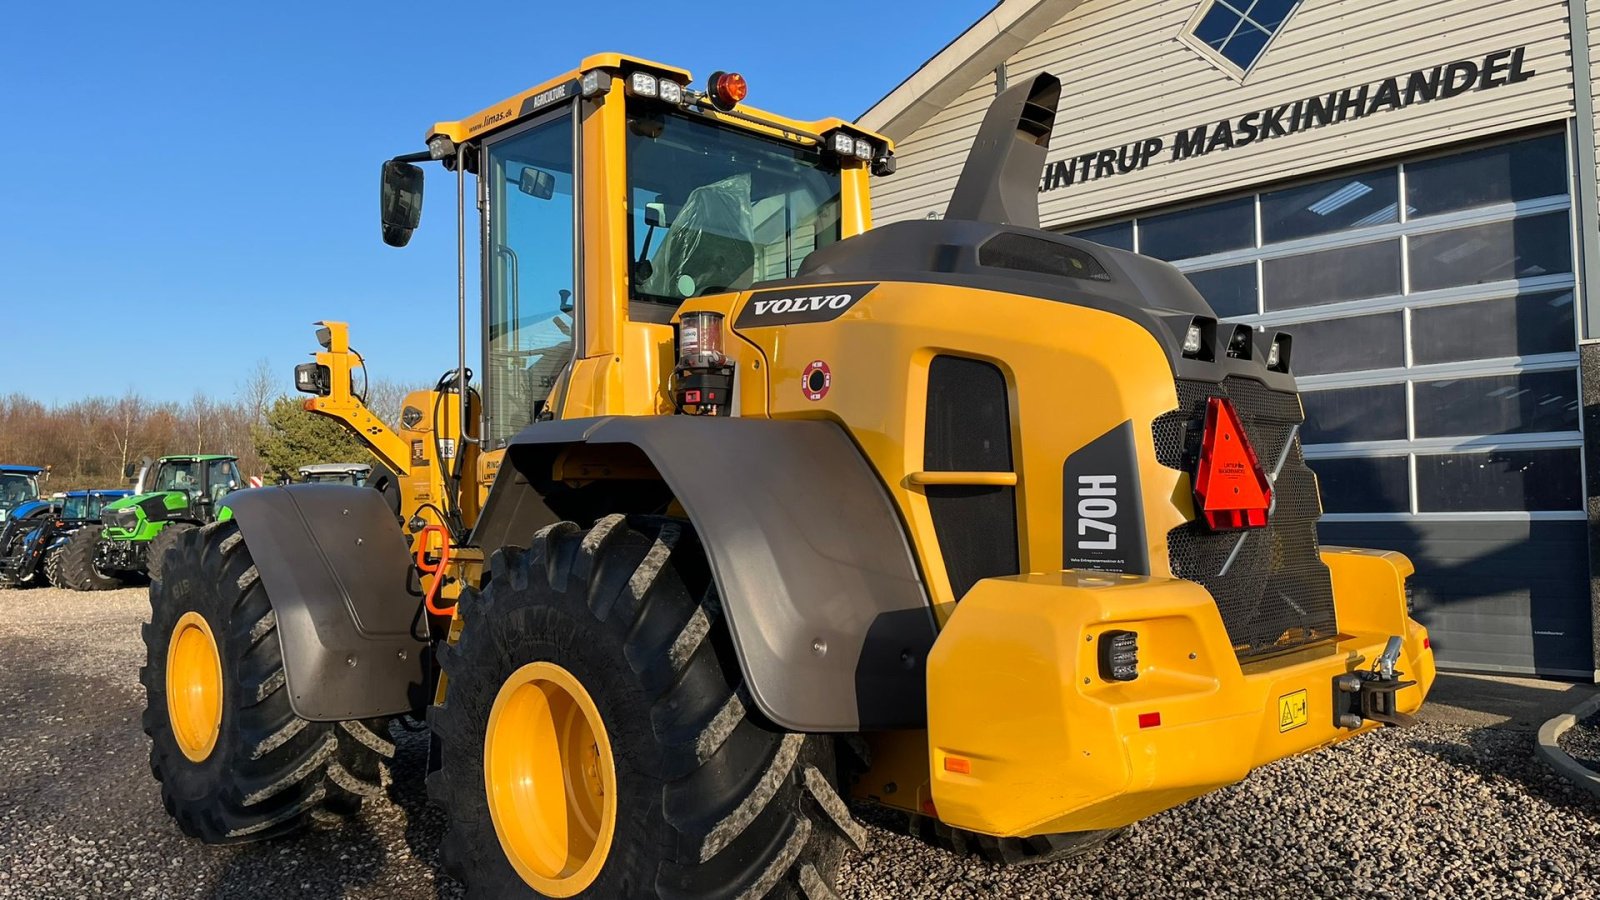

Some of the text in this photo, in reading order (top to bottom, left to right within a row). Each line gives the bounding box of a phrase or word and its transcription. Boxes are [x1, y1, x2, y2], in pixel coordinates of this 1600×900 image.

[533, 84, 566, 109] AGRICULTURE
[468, 108, 513, 133] www.limas.dk
[1038, 46, 1535, 192] INTRUP MASKINHANDEL
[753, 294, 852, 315] VOLVO
[1078, 474, 1117, 550] L70H
